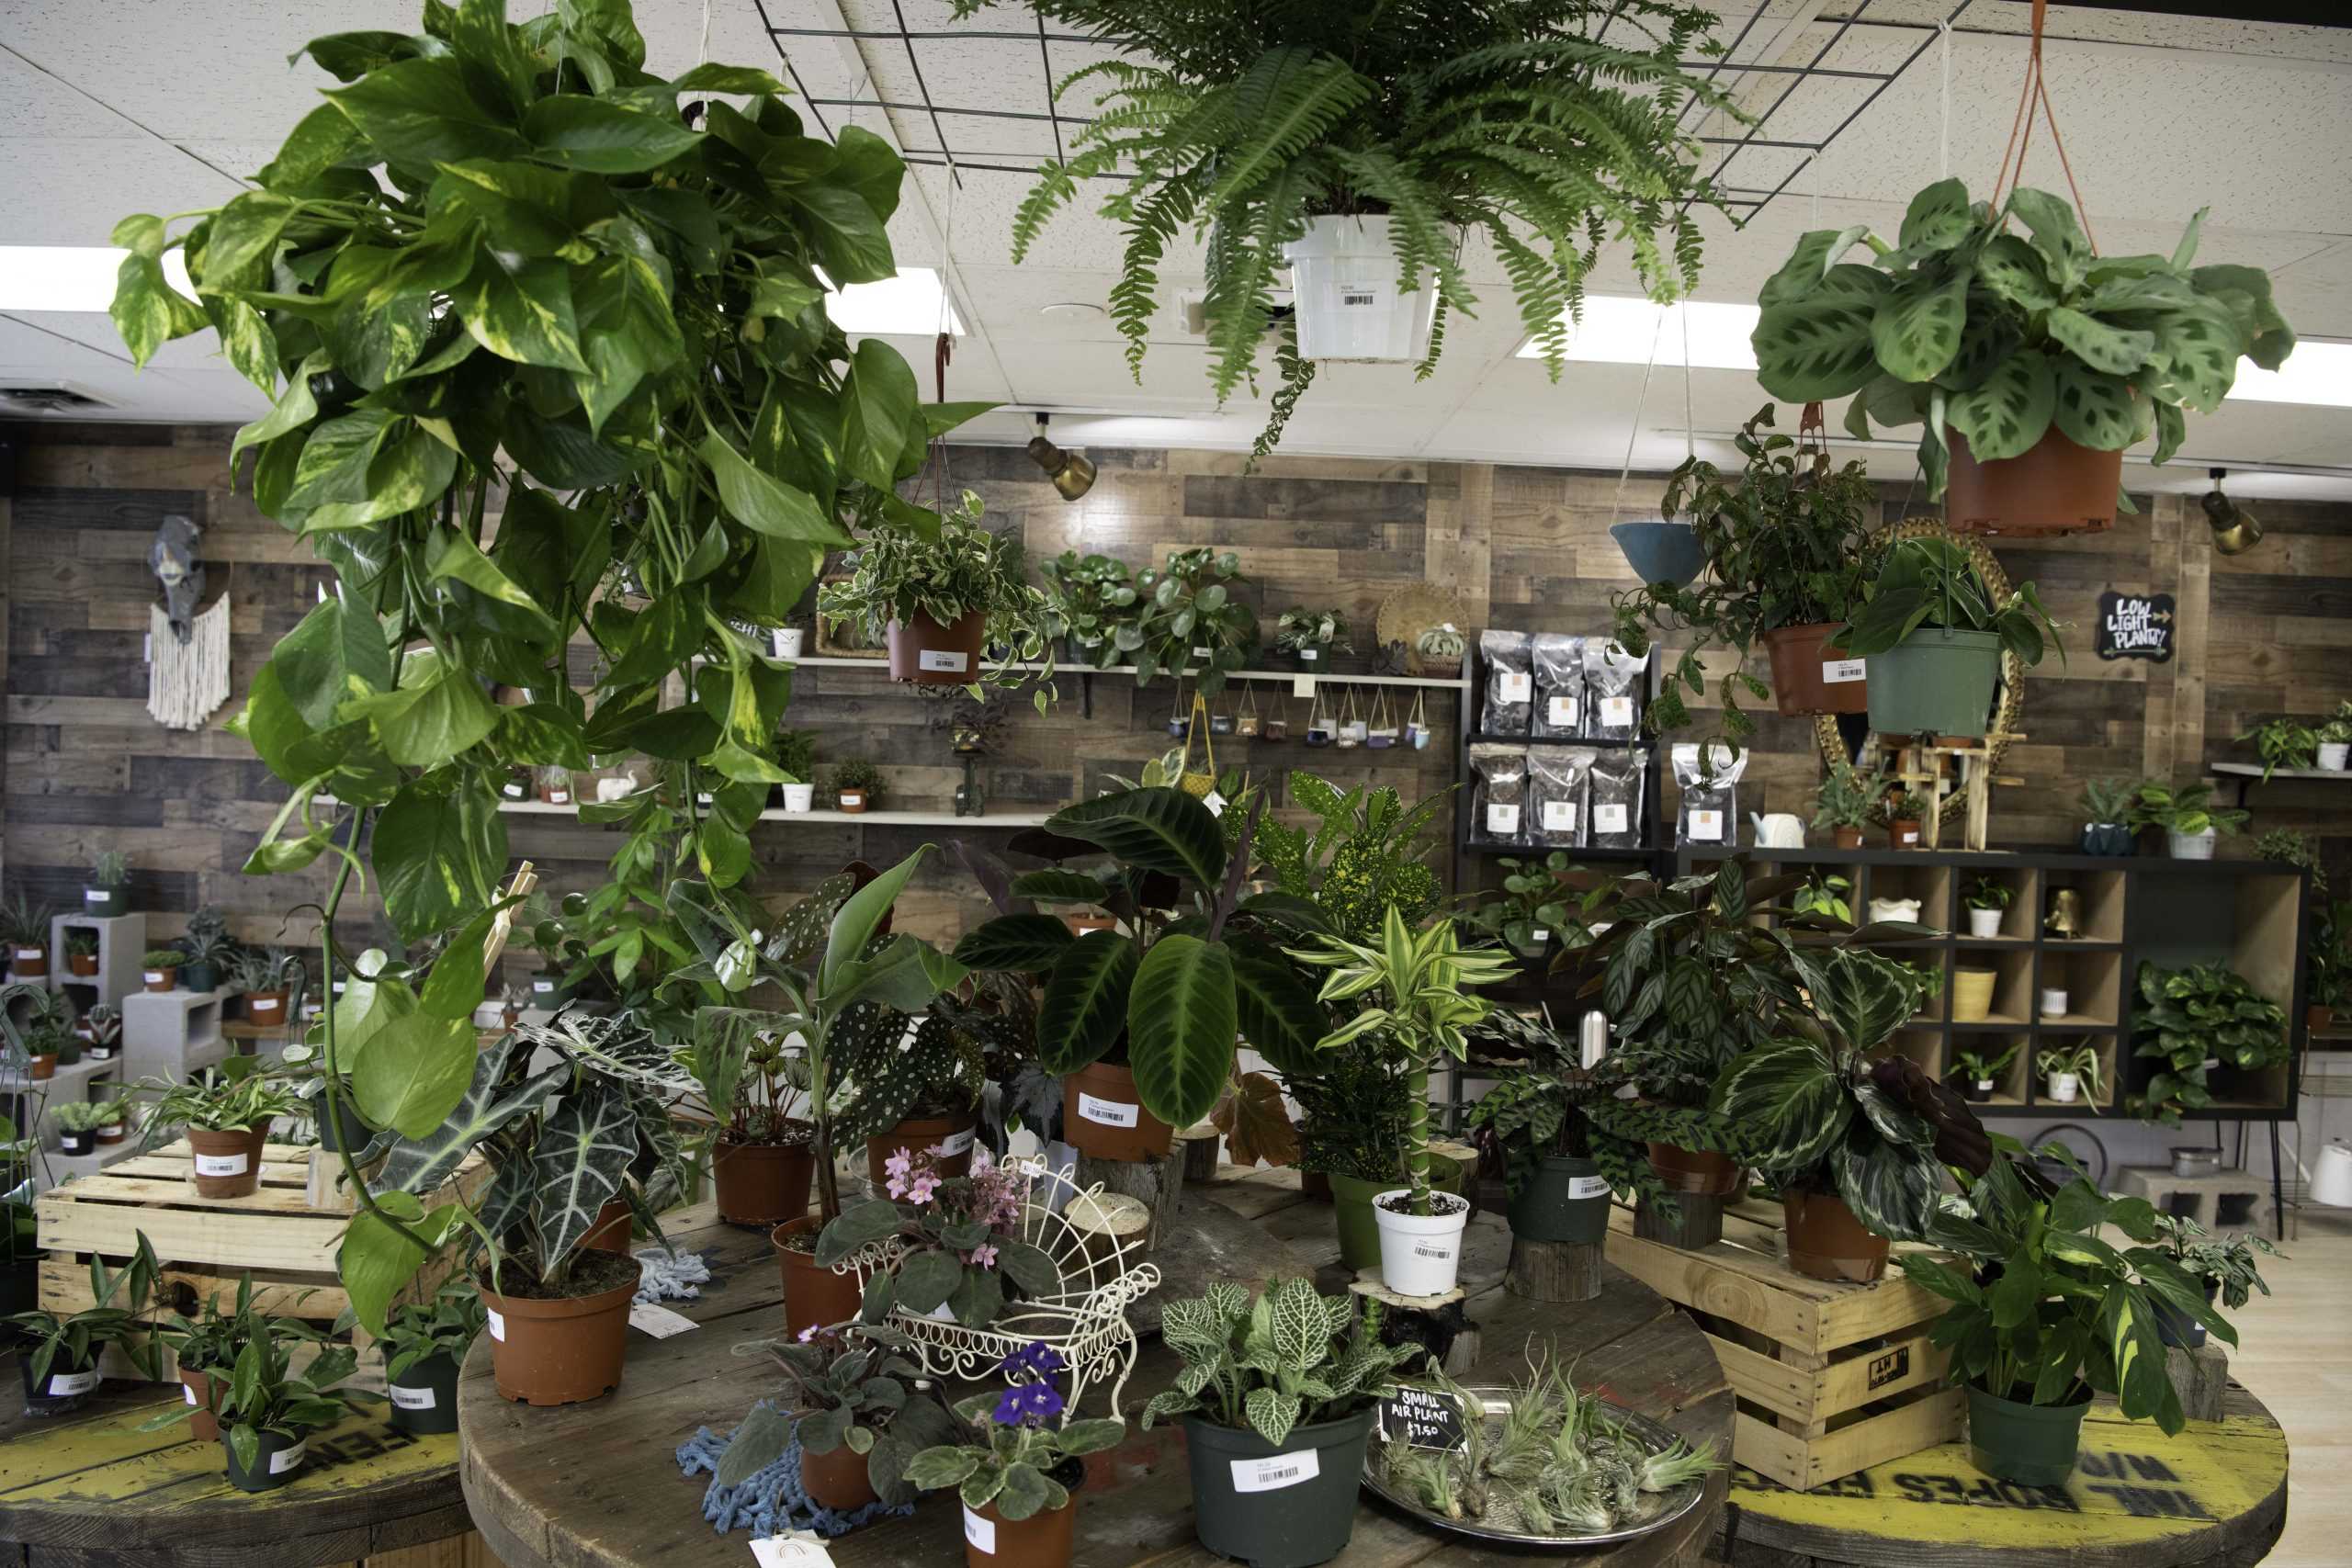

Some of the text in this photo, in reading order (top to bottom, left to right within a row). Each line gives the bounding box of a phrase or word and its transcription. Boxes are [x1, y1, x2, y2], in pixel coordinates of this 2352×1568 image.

[2116, 598, 2151, 616] LOW
[2107, 614, 2152, 631] LIGHT
[2113, 628, 2166, 649] PLANTS!
[1402, 1391, 1440, 1408] SMALL
[1391, 1404, 1449, 1423] AIR PLANT
[1408, 1420, 1438, 1437] $7.50
